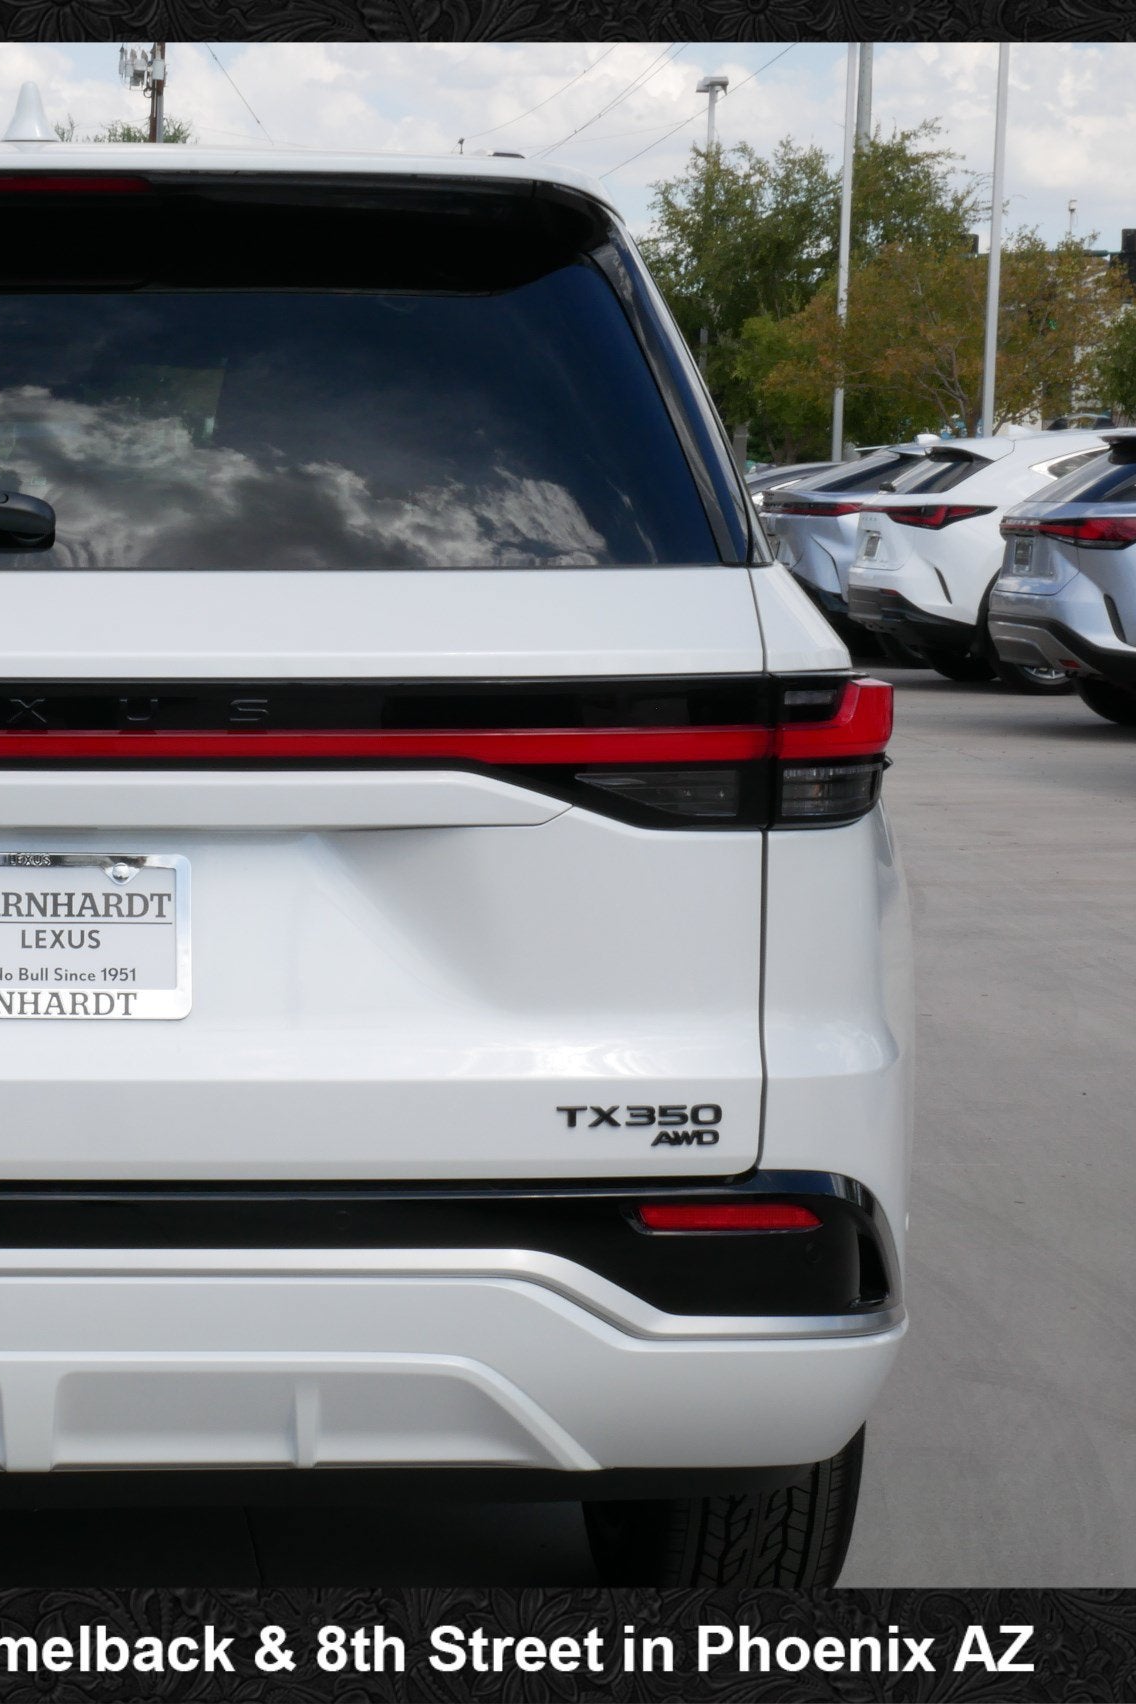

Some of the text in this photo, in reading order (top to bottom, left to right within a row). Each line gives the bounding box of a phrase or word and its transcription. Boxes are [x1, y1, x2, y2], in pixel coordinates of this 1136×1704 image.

[21, 929, 101, 949] LEXUS
[19, 967, 49, 982] Bull
[54, 967, 96, 982] Since
[101, 968, 137, 982] 1951
[650, 1129, 720, 1147] AWD
